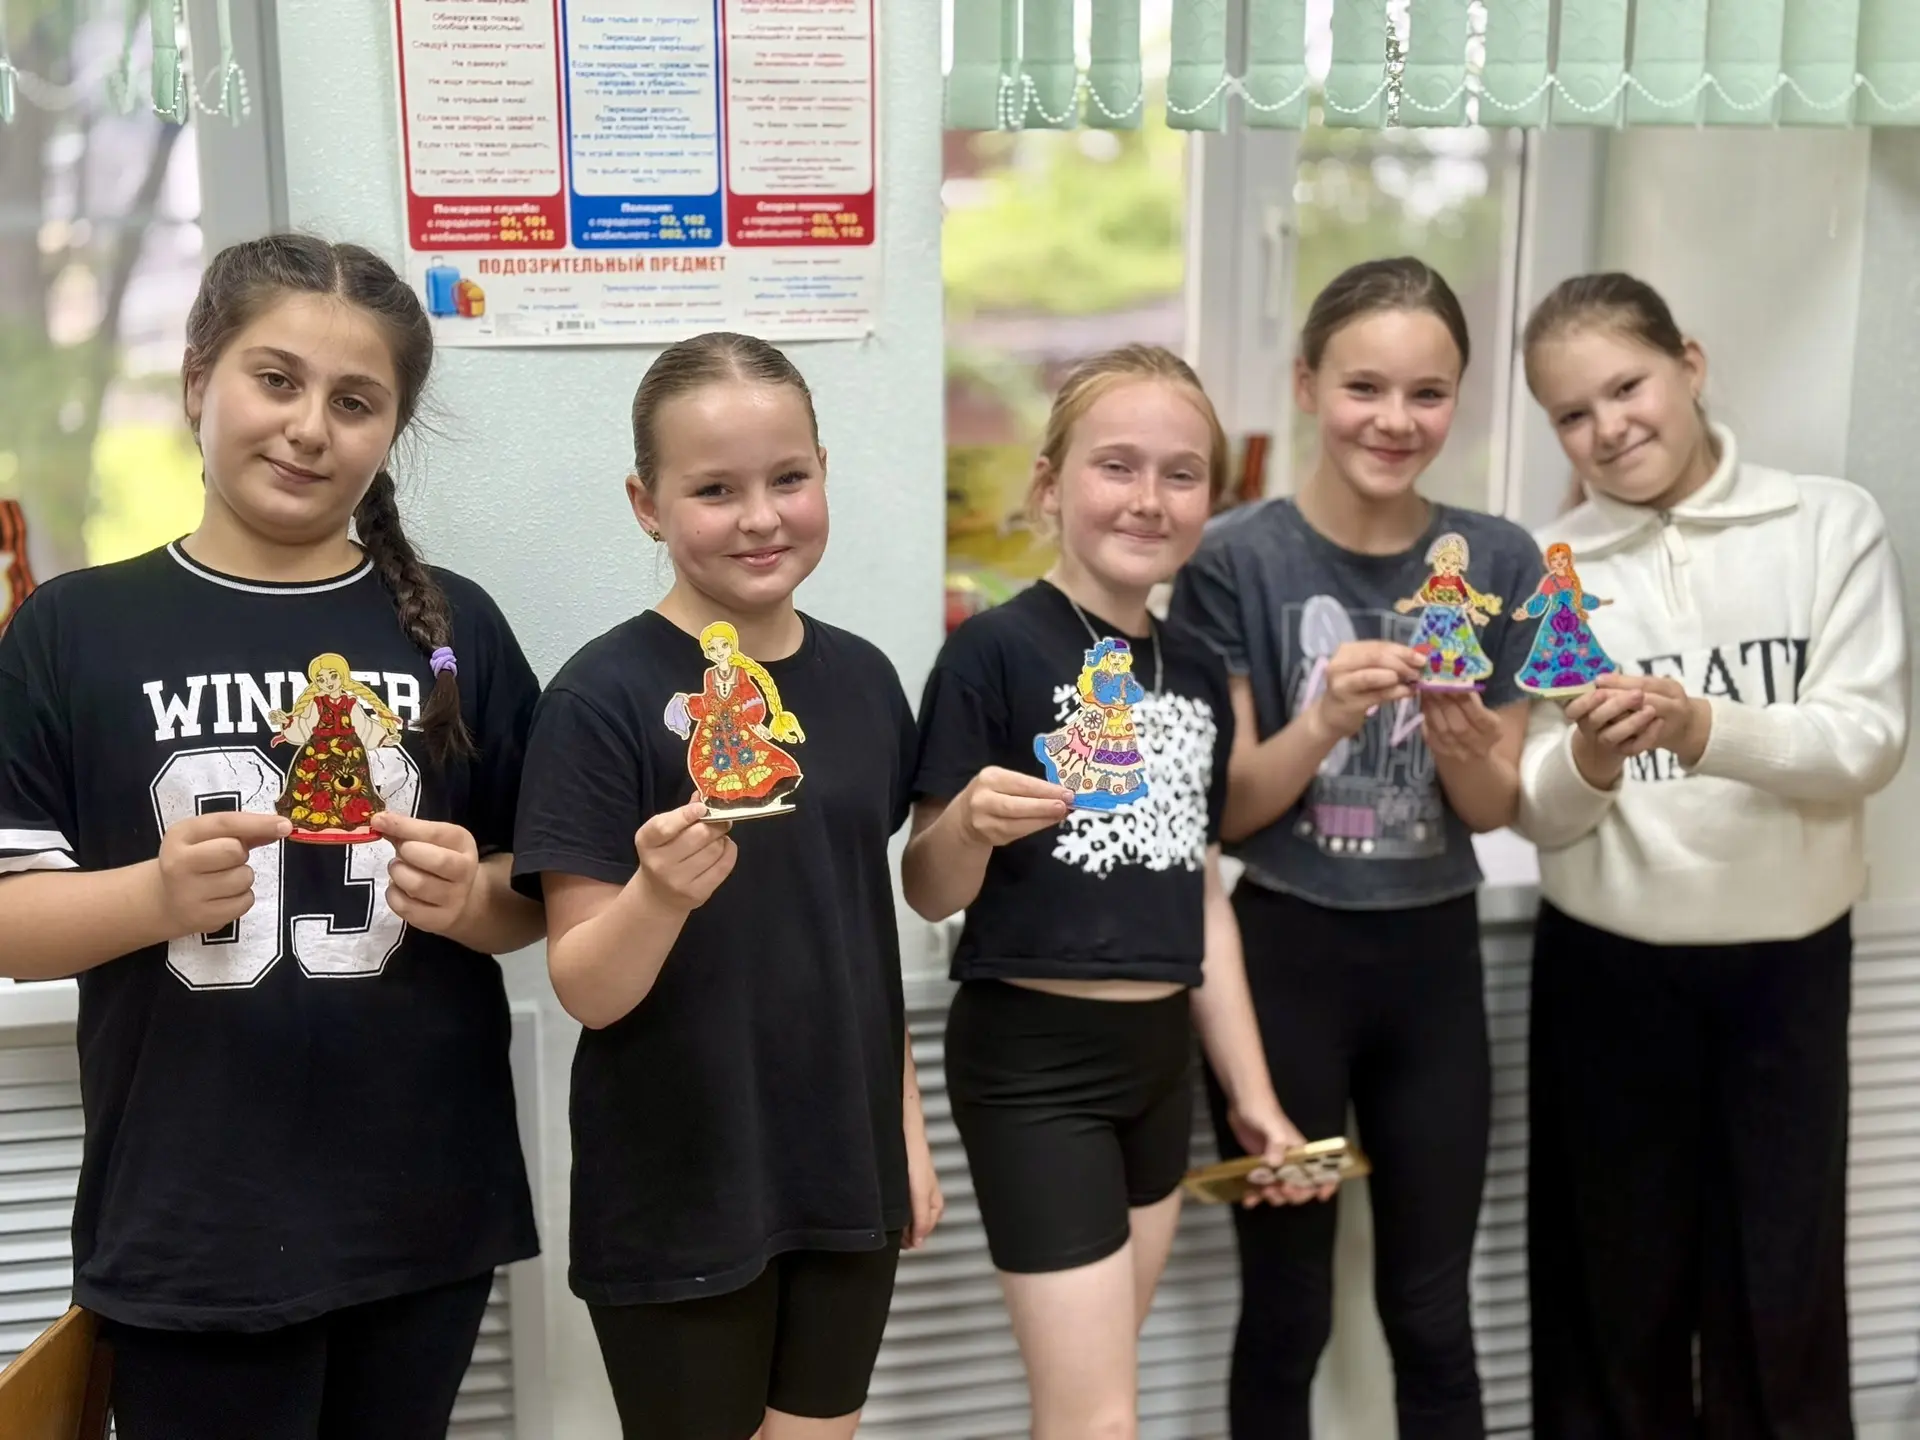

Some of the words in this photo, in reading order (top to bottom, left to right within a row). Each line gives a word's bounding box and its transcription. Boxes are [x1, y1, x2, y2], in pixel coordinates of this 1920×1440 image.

[478, 254, 645, 275] ПОДОЗРИТЕЛЬНЫЙ
[650, 256, 726, 273] ПРЕДМЕТ
[143, 670, 425, 741] WINR
